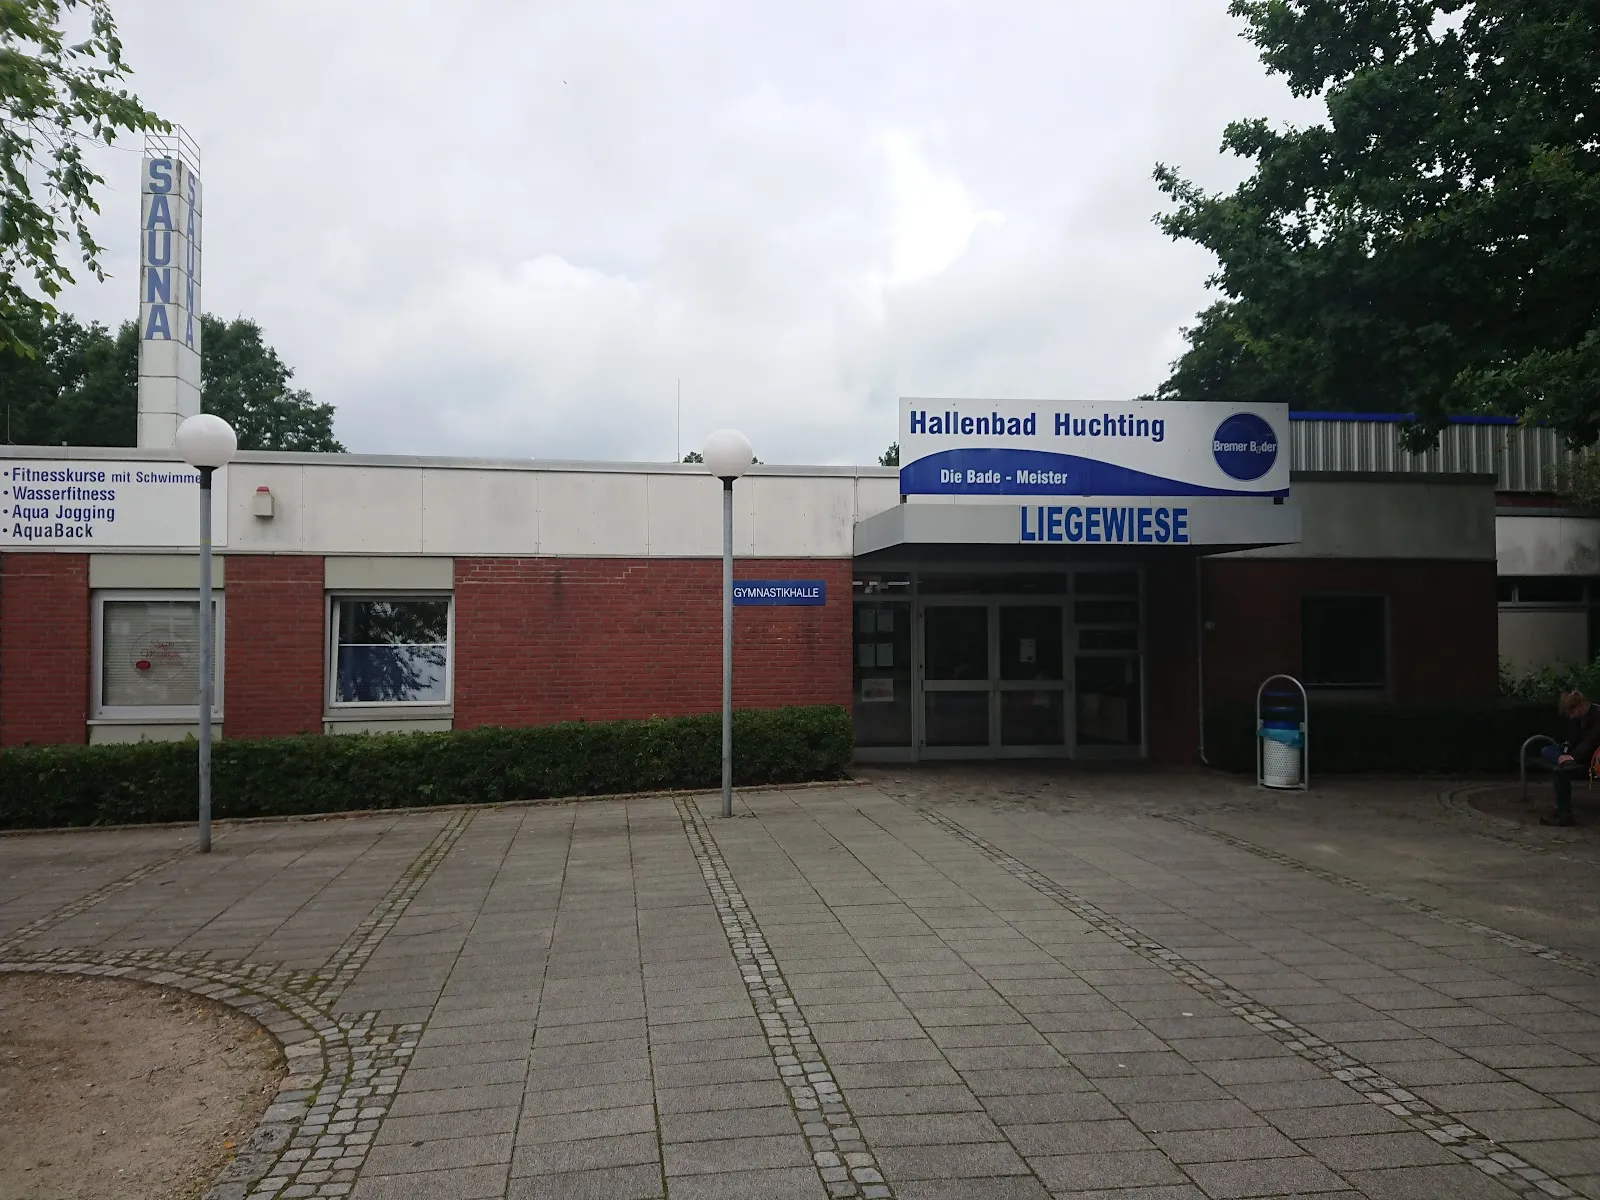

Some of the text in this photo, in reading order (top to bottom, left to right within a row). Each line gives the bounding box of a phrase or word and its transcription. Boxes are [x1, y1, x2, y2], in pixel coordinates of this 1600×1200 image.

[145, 159, 172, 340] SAUNA
[186, 170, 196, 350] SAUNA
[910, 411, 1165, 442] Hallenbad Huchting
[1213, 440, 1248, 452] Bremer
[12, 468, 201, 484] Fitnesskurse mit Schwimme
[940, 469, 962, 484] Die
[966, 469, 1001, 485] Bade
[1016, 470, 1068, 485] Meister
[13, 486, 115, 500] Wasserfitness
[12, 505, 115, 522] Aqua Jogging
[12, 523, 93, 540] AquaBack
[1021, 507, 1189, 543] LIEGEWIESE
[734, 588, 819, 598] GYMNASTIKHALLE
